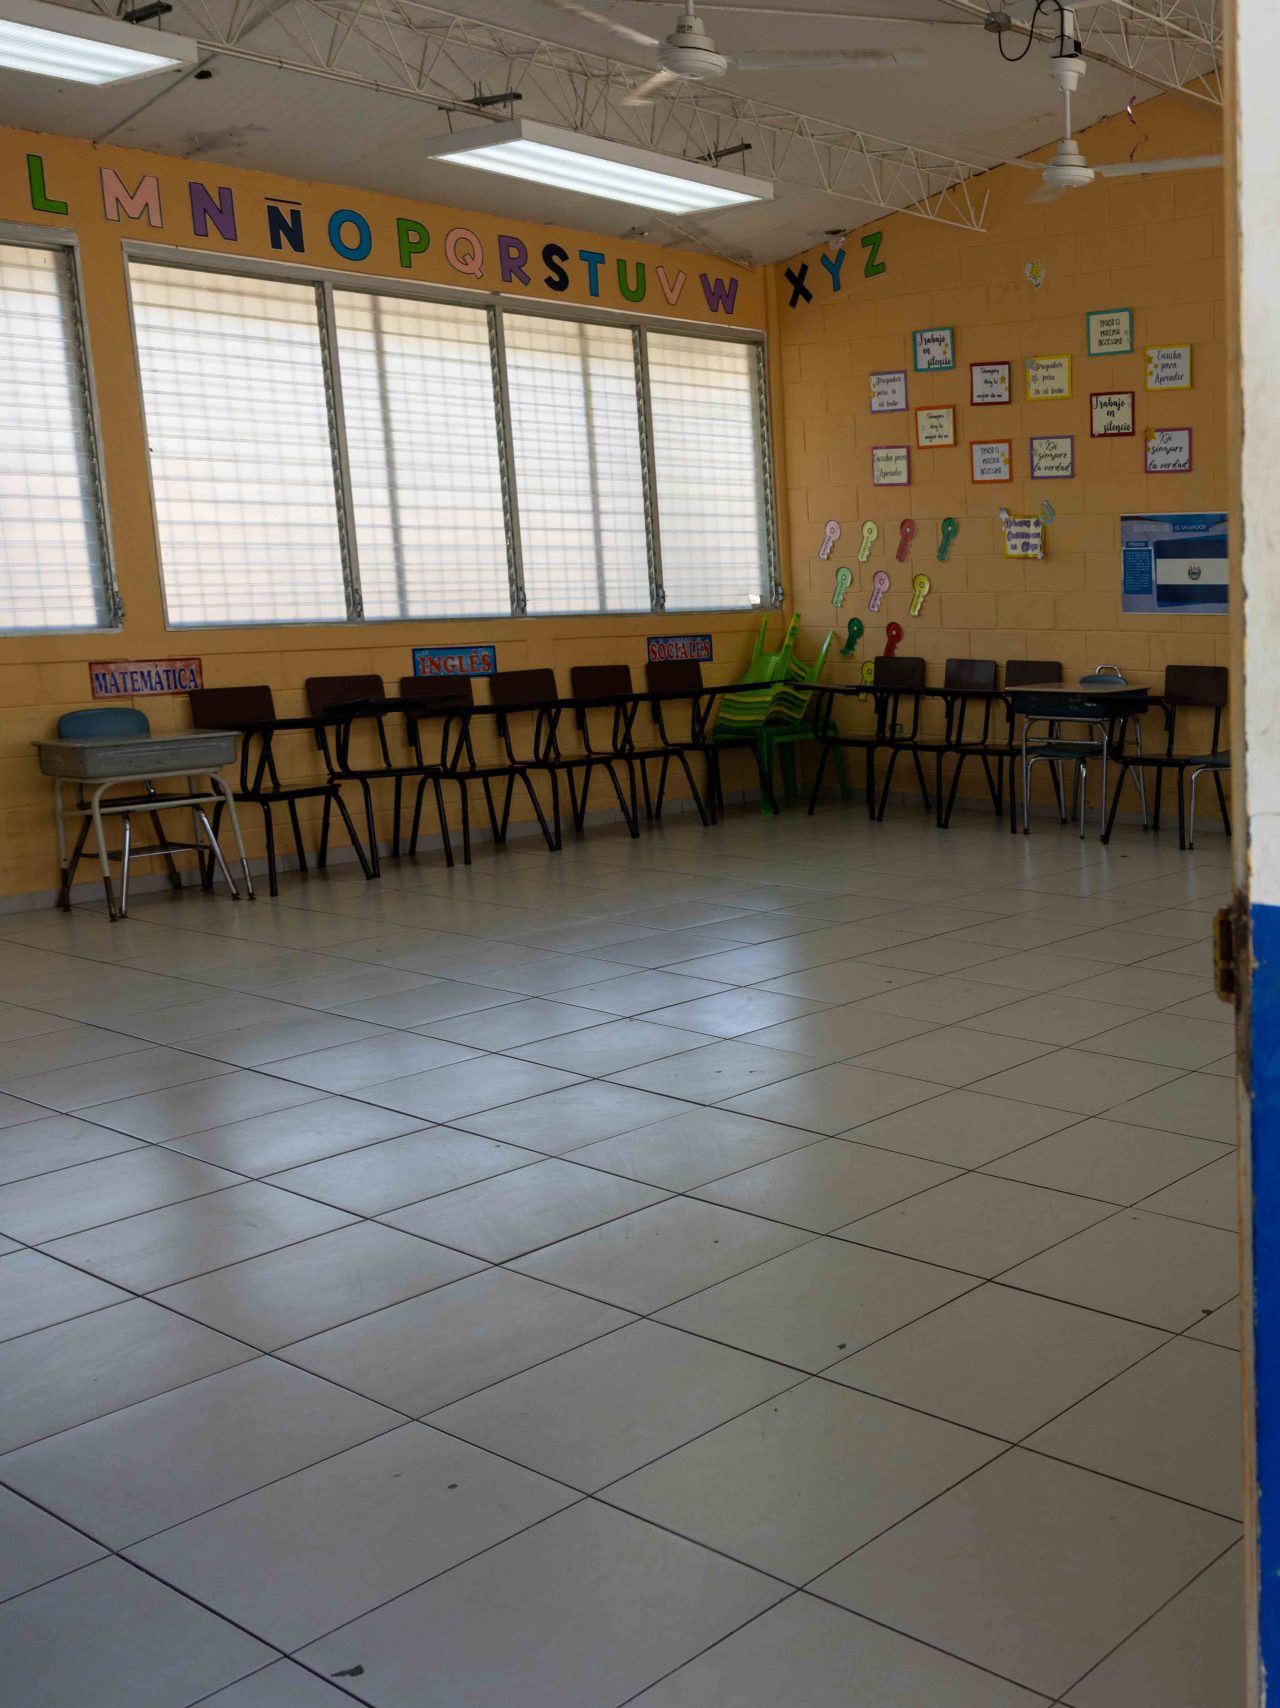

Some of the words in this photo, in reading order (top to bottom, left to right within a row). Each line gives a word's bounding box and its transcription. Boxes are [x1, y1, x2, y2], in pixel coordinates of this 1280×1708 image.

[27, 154, 68, 215] L
[100, 167, 163, 228] M
[188, 181, 237, 241] N
[328, 209, 372, 261] O
[396, 217, 430, 268] P
[444, 228, 484, 279] Q
[498, 235, 531, 285] R
[542, 244, 569, 291] S
[579, 250, 605, 297] T
[617, 259, 646, 302] U
[655, 266, 687, 305] V
[700, 273, 738, 314] W
[784, 262, 813, 309] X
[820, 248, 846, 291] Y
[860, 231, 886, 278] Z
[928, 356, 951, 368] silencio
[1161, 363, 1177, 372] para
[1155, 372, 1184, 385] Aprender
[1104, 421, 1130, 433] silencio
[1150, 445, 1183, 455] siempre
[1038, 452, 1068, 461] siempre
[1033, 463, 1041, 472] la
[1044, 462, 1072, 472] verdad
[1149, 460, 1157, 470] la
[1160, 459, 1188, 469] verdad
[650, 640, 710, 660] SOCIALES
[420, 650, 492, 674] INGLÉS
[94, 664, 199, 694] MATEMÁTICA
